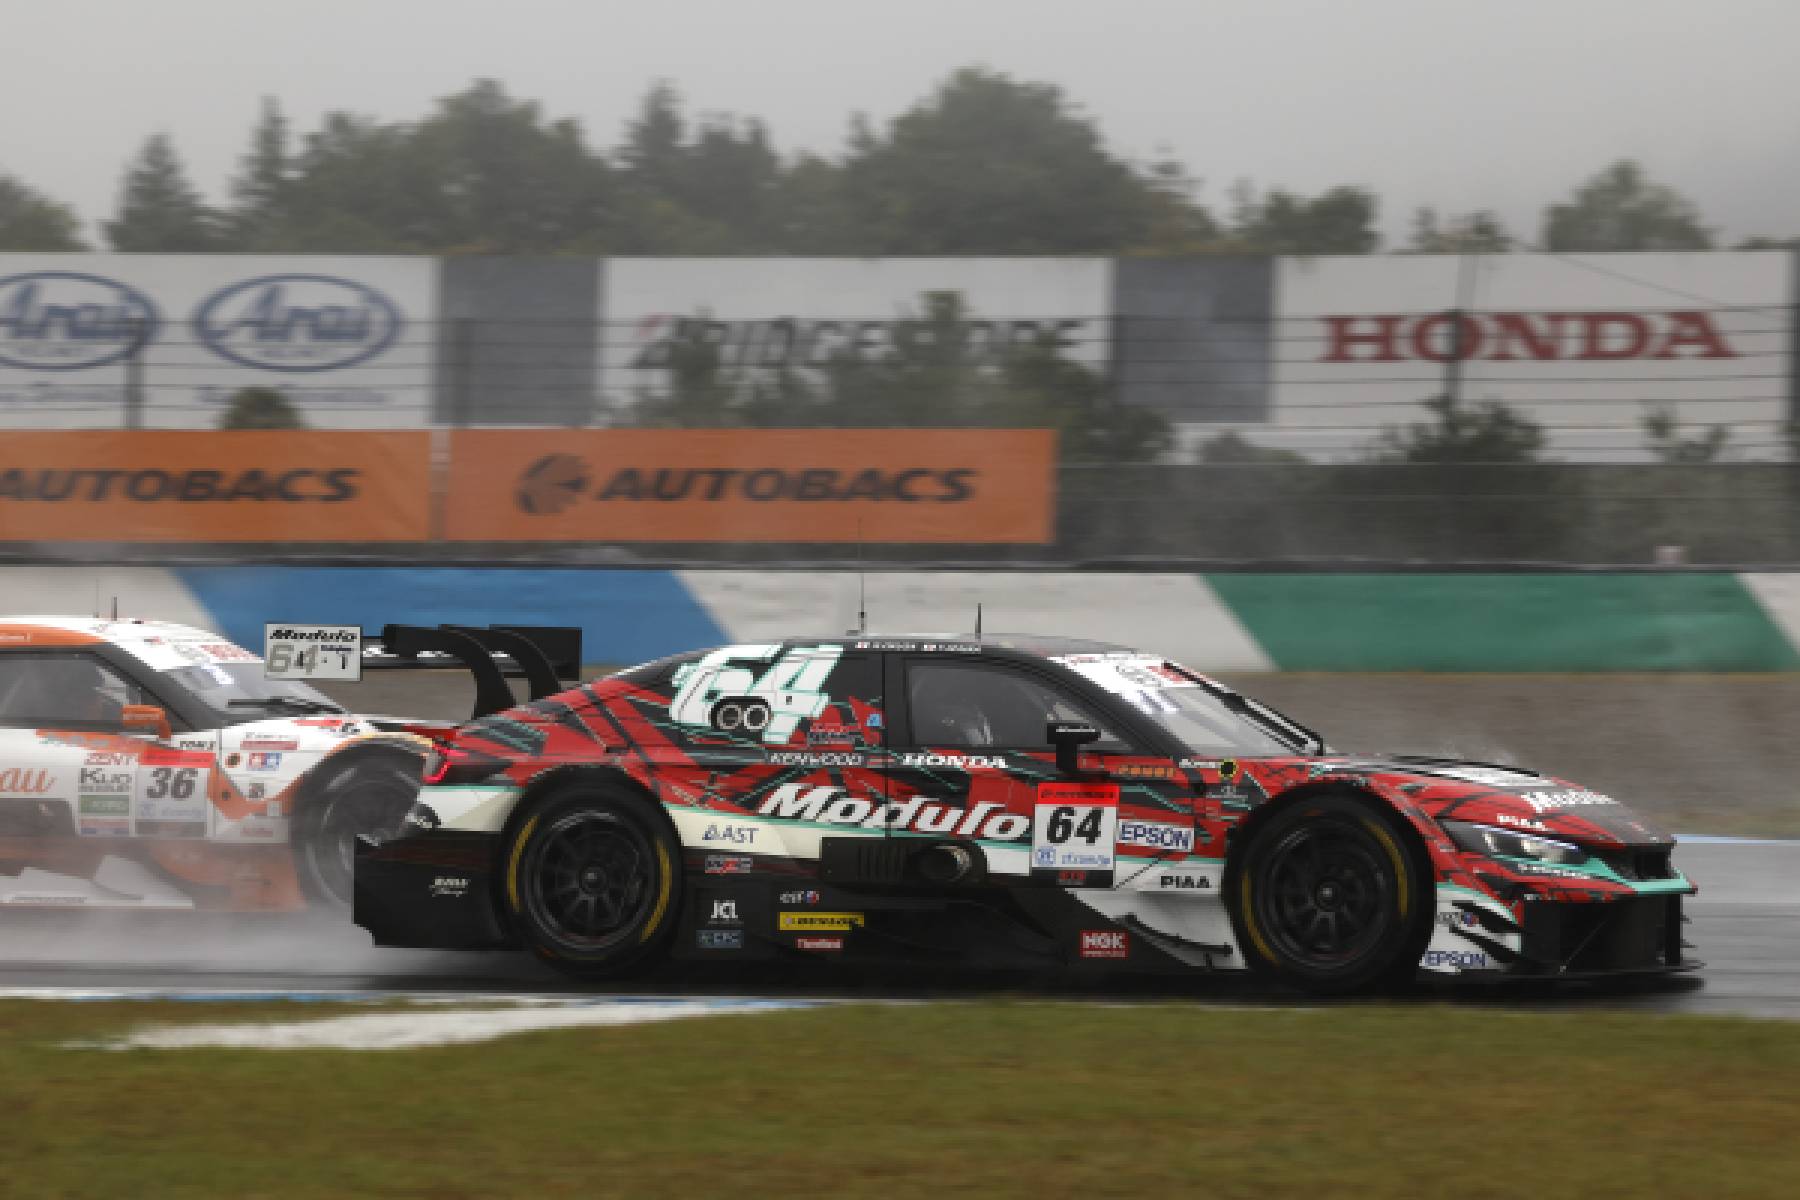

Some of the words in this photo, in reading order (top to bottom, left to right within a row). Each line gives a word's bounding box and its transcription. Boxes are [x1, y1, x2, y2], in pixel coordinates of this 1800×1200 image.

[1318, 311, 1736, 362] HONDA
[0, 468, 362, 501] AUTOBACS
[600, 468, 978, 502] AUTOBACS
[668, 642, 842, 744] 64
[84, 752, 137, 766] ZENT
[769, 752, 864, 767] KENWOOD
[901, 753, 1009, 769] HONDA
[146, 767, 199, 799] 36
[758, 782, 1031, 840] Modulo
[1046, 806, 1104, 844] 64
[1119, 823, 1189, 851] EPSON
[1160, 875, 1210, 889] PIAA
[1082, 932, 1126, 949] NGK
[1424, 950, 1488, 968] EPSON
